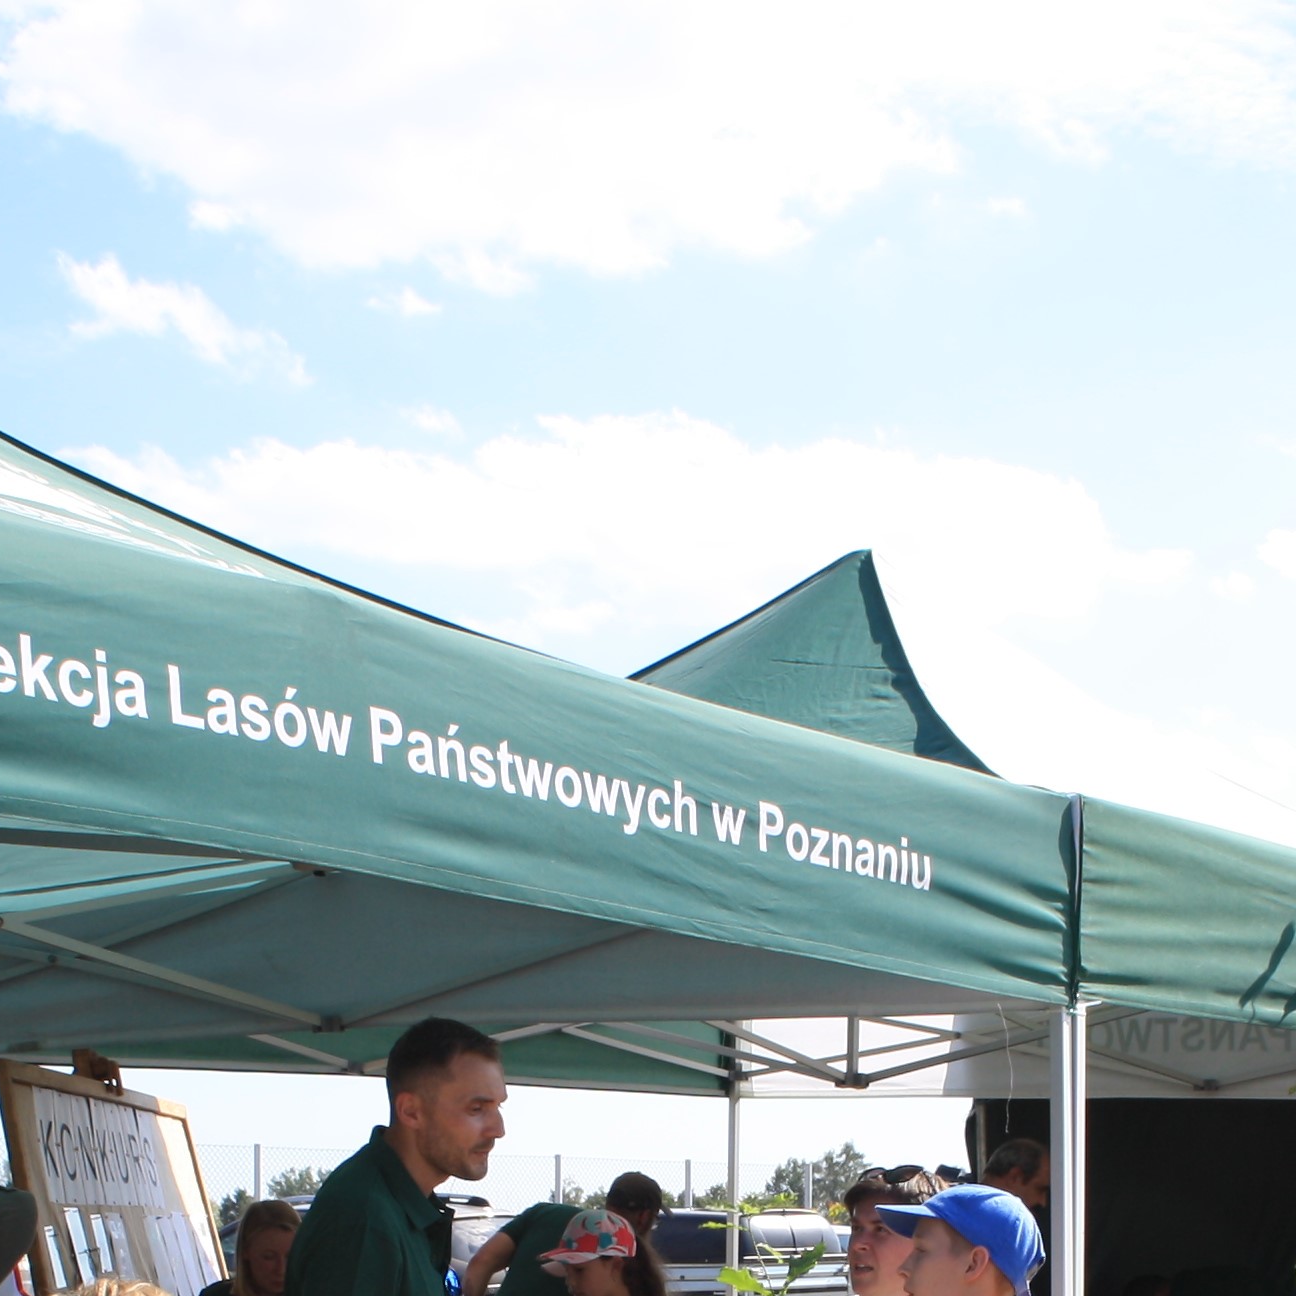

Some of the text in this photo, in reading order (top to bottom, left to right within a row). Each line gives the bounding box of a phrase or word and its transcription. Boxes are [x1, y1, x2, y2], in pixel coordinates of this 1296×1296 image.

[168, 664, 352, 756] Lasów
[370, 706, 699, 835] Państwowych
[710, 807, 746, 845] w
[759, 801, 932, 890] Poznaniu
[40, 1119, 157, 1187] KONKURS
